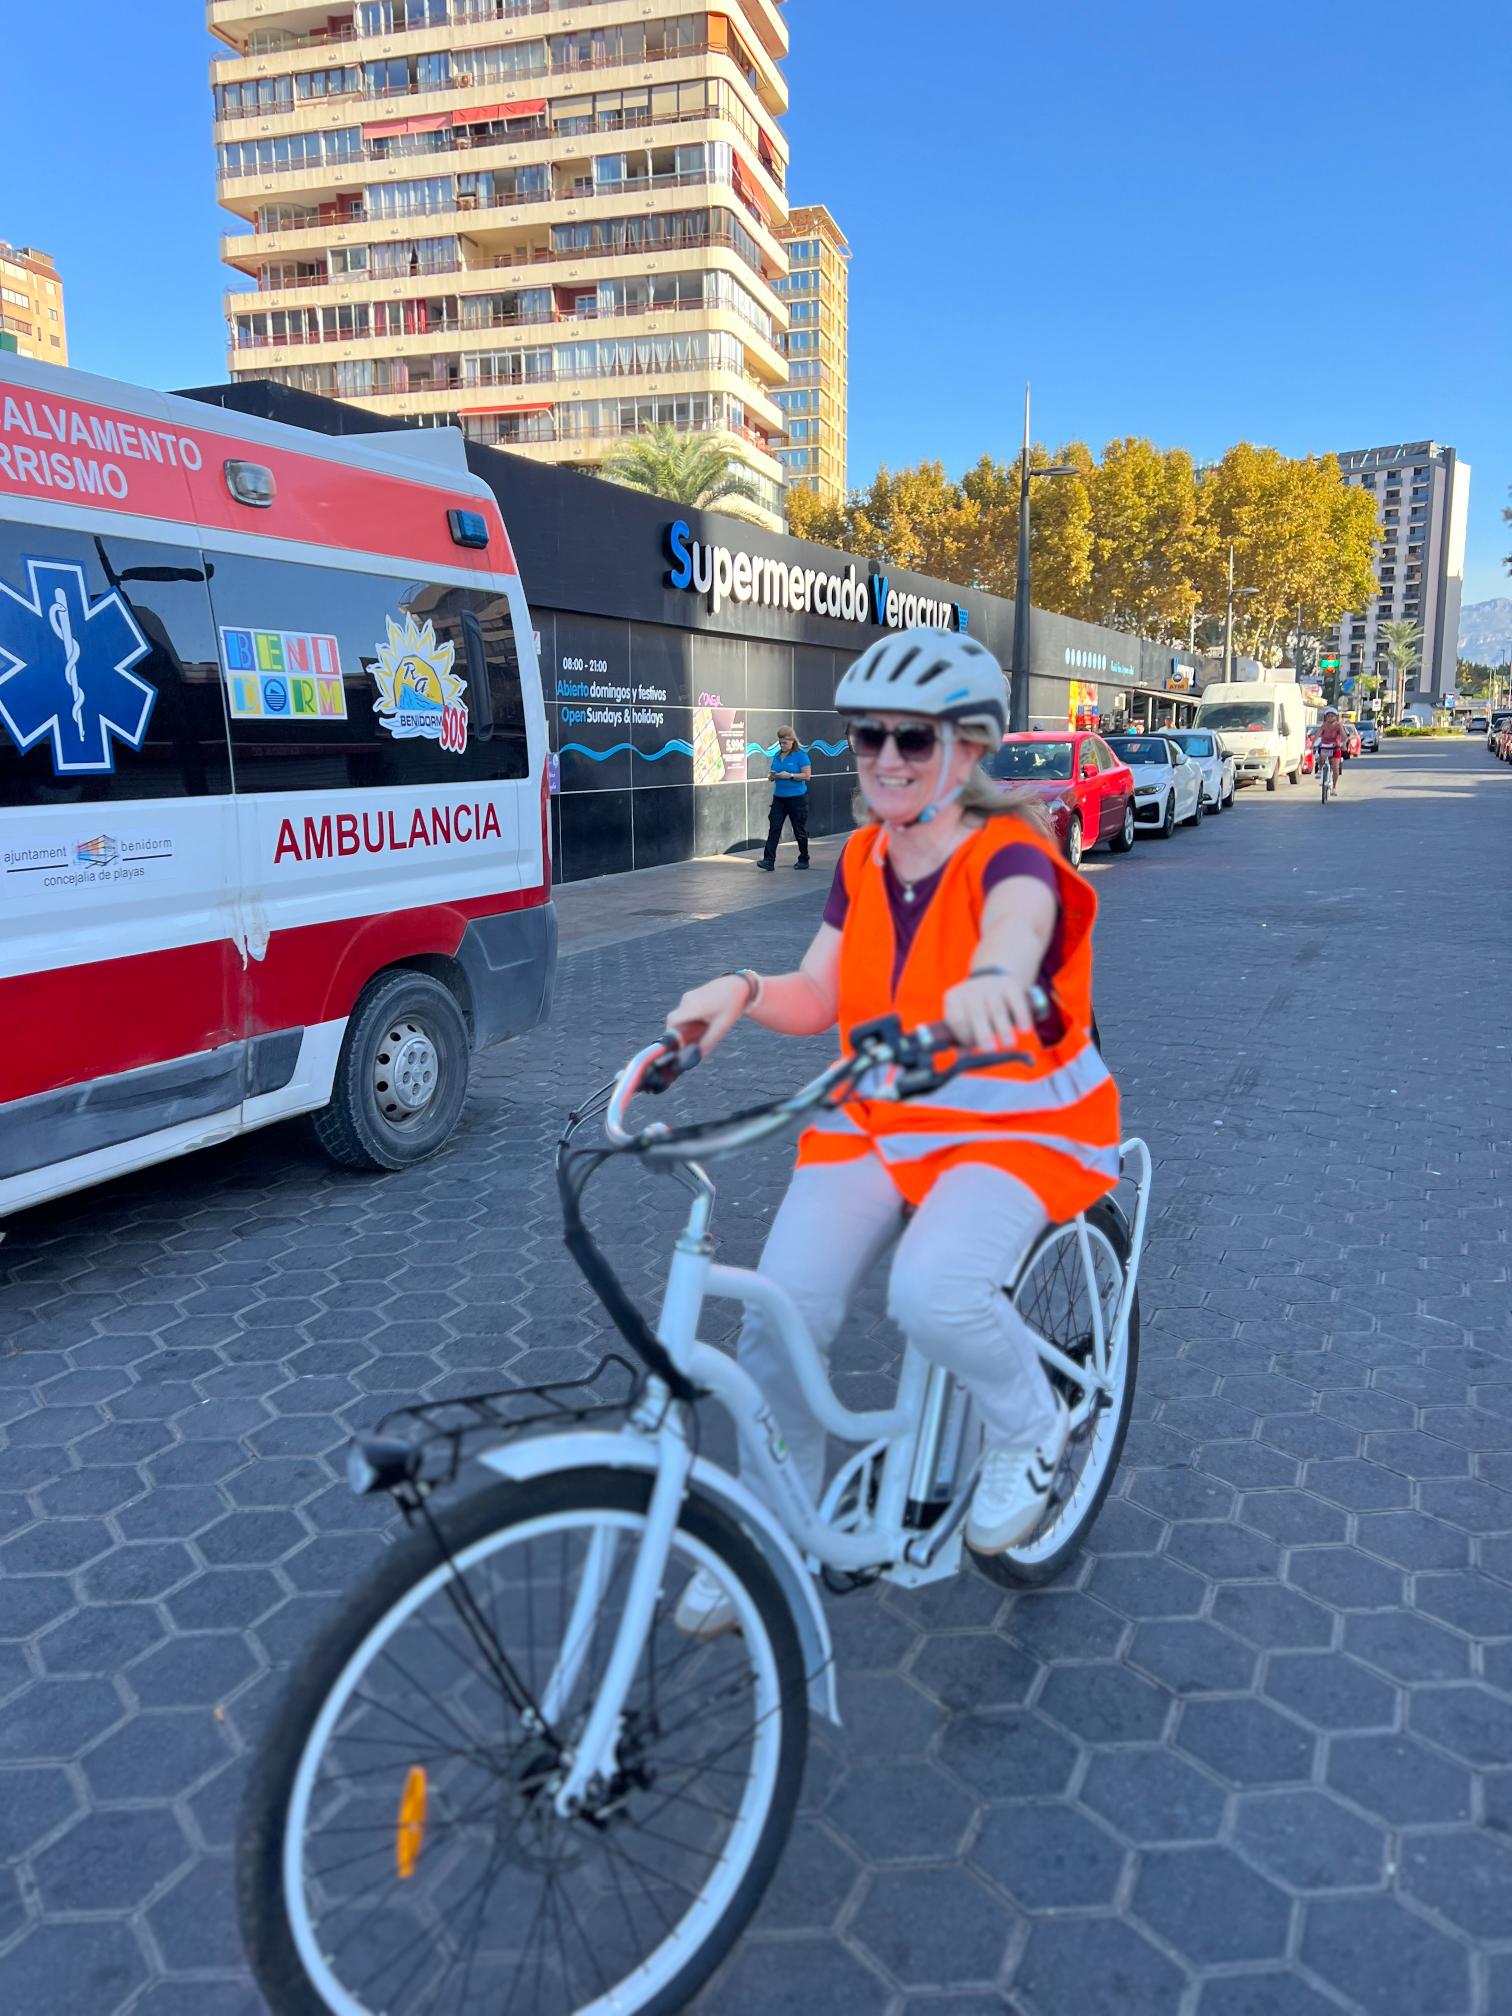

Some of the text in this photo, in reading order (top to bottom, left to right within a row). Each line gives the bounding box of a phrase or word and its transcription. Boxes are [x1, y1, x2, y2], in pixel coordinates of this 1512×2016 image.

[670, 520, 952, 629] Supermercado Veracruz
[562, 657, 584, 671] 08:00
[589, 659, 608, 673] 21:00
[557, 680, 667, 703] Abierto domingos y festivos
[441, 705, 465, 750] SOS
[561, 707, 664, 728] Open Sundays & holidays
[274, 803, 501, 864] AMBULANCIA
[4, 847, 67, 864] ajuntament
[121, 838, 173, 852] benidorm
[99, 869, 111, 881] de
[113, 867, 145, 880] playas
